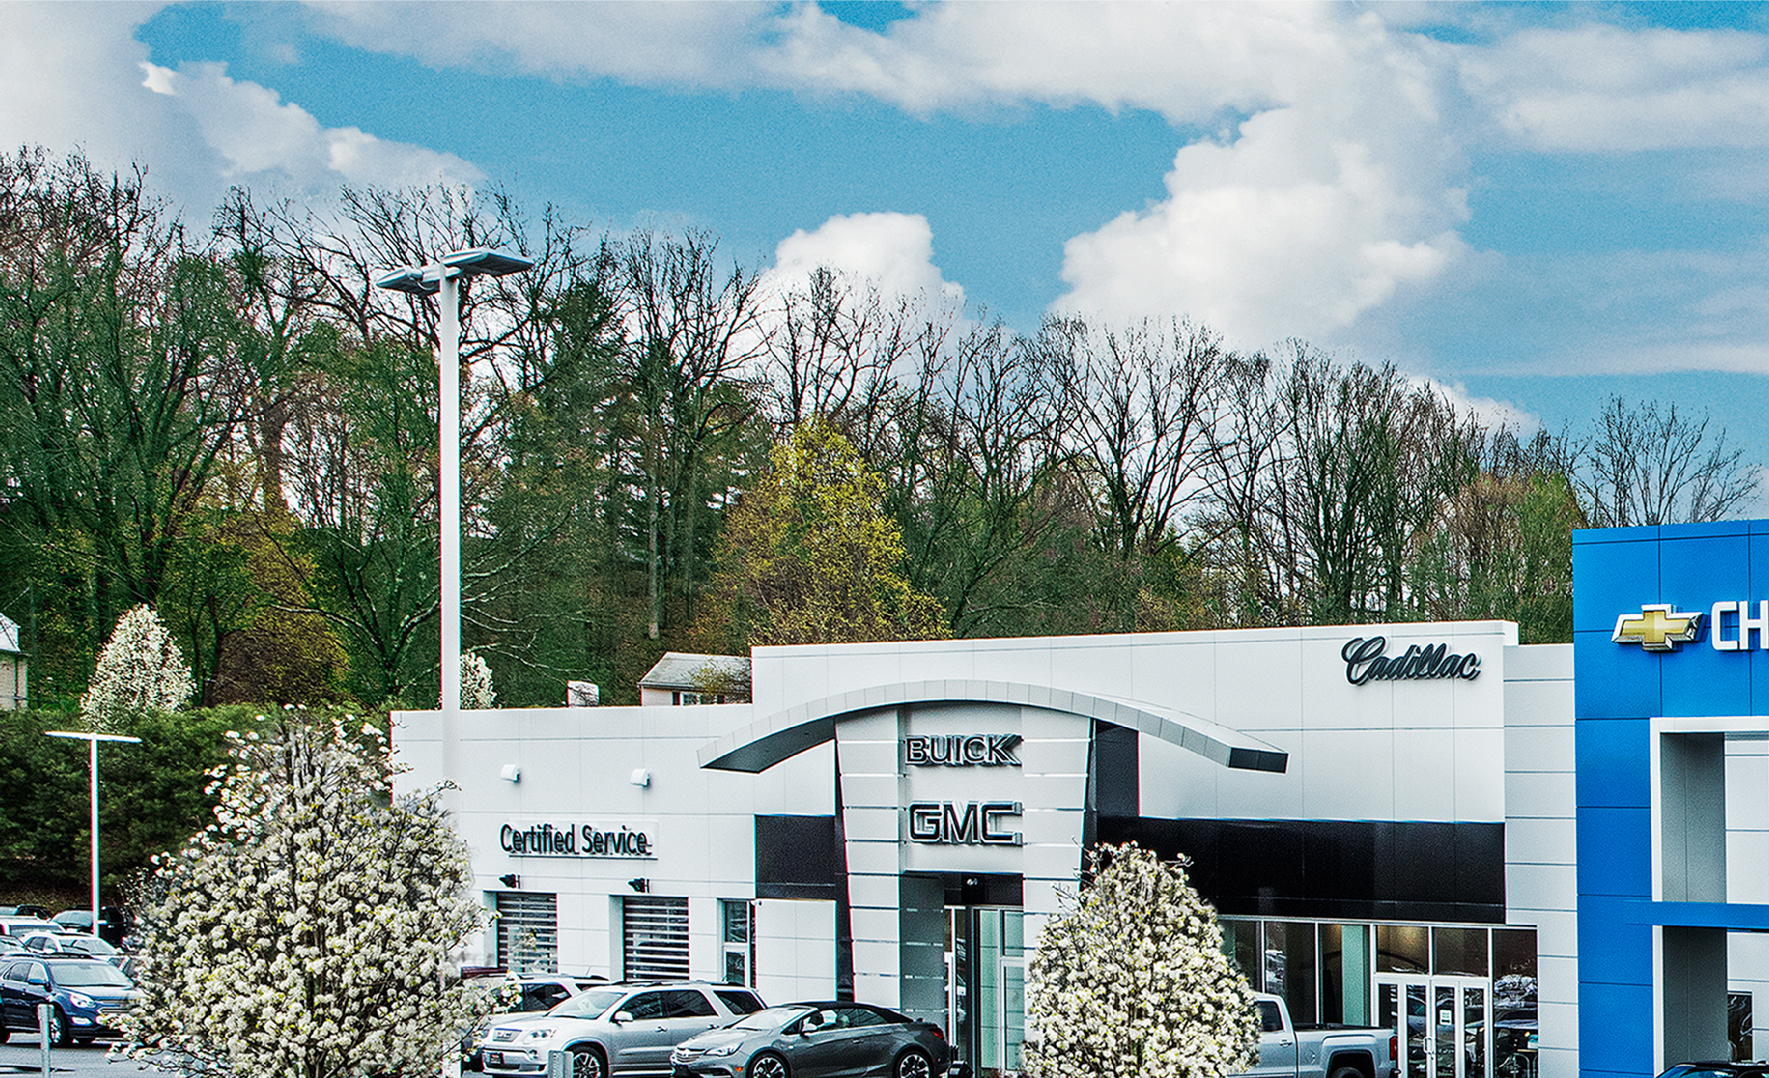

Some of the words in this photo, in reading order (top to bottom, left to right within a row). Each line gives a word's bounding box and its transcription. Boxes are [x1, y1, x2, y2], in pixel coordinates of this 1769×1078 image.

[1341, 636, 1481, 685] Cadillac
[905, 735, 1023, 767] BUICK
[500, 823, 577, 855] Certified
[581, 824, 653, 856] Service
[908, 801, 1023, 846] GMC
